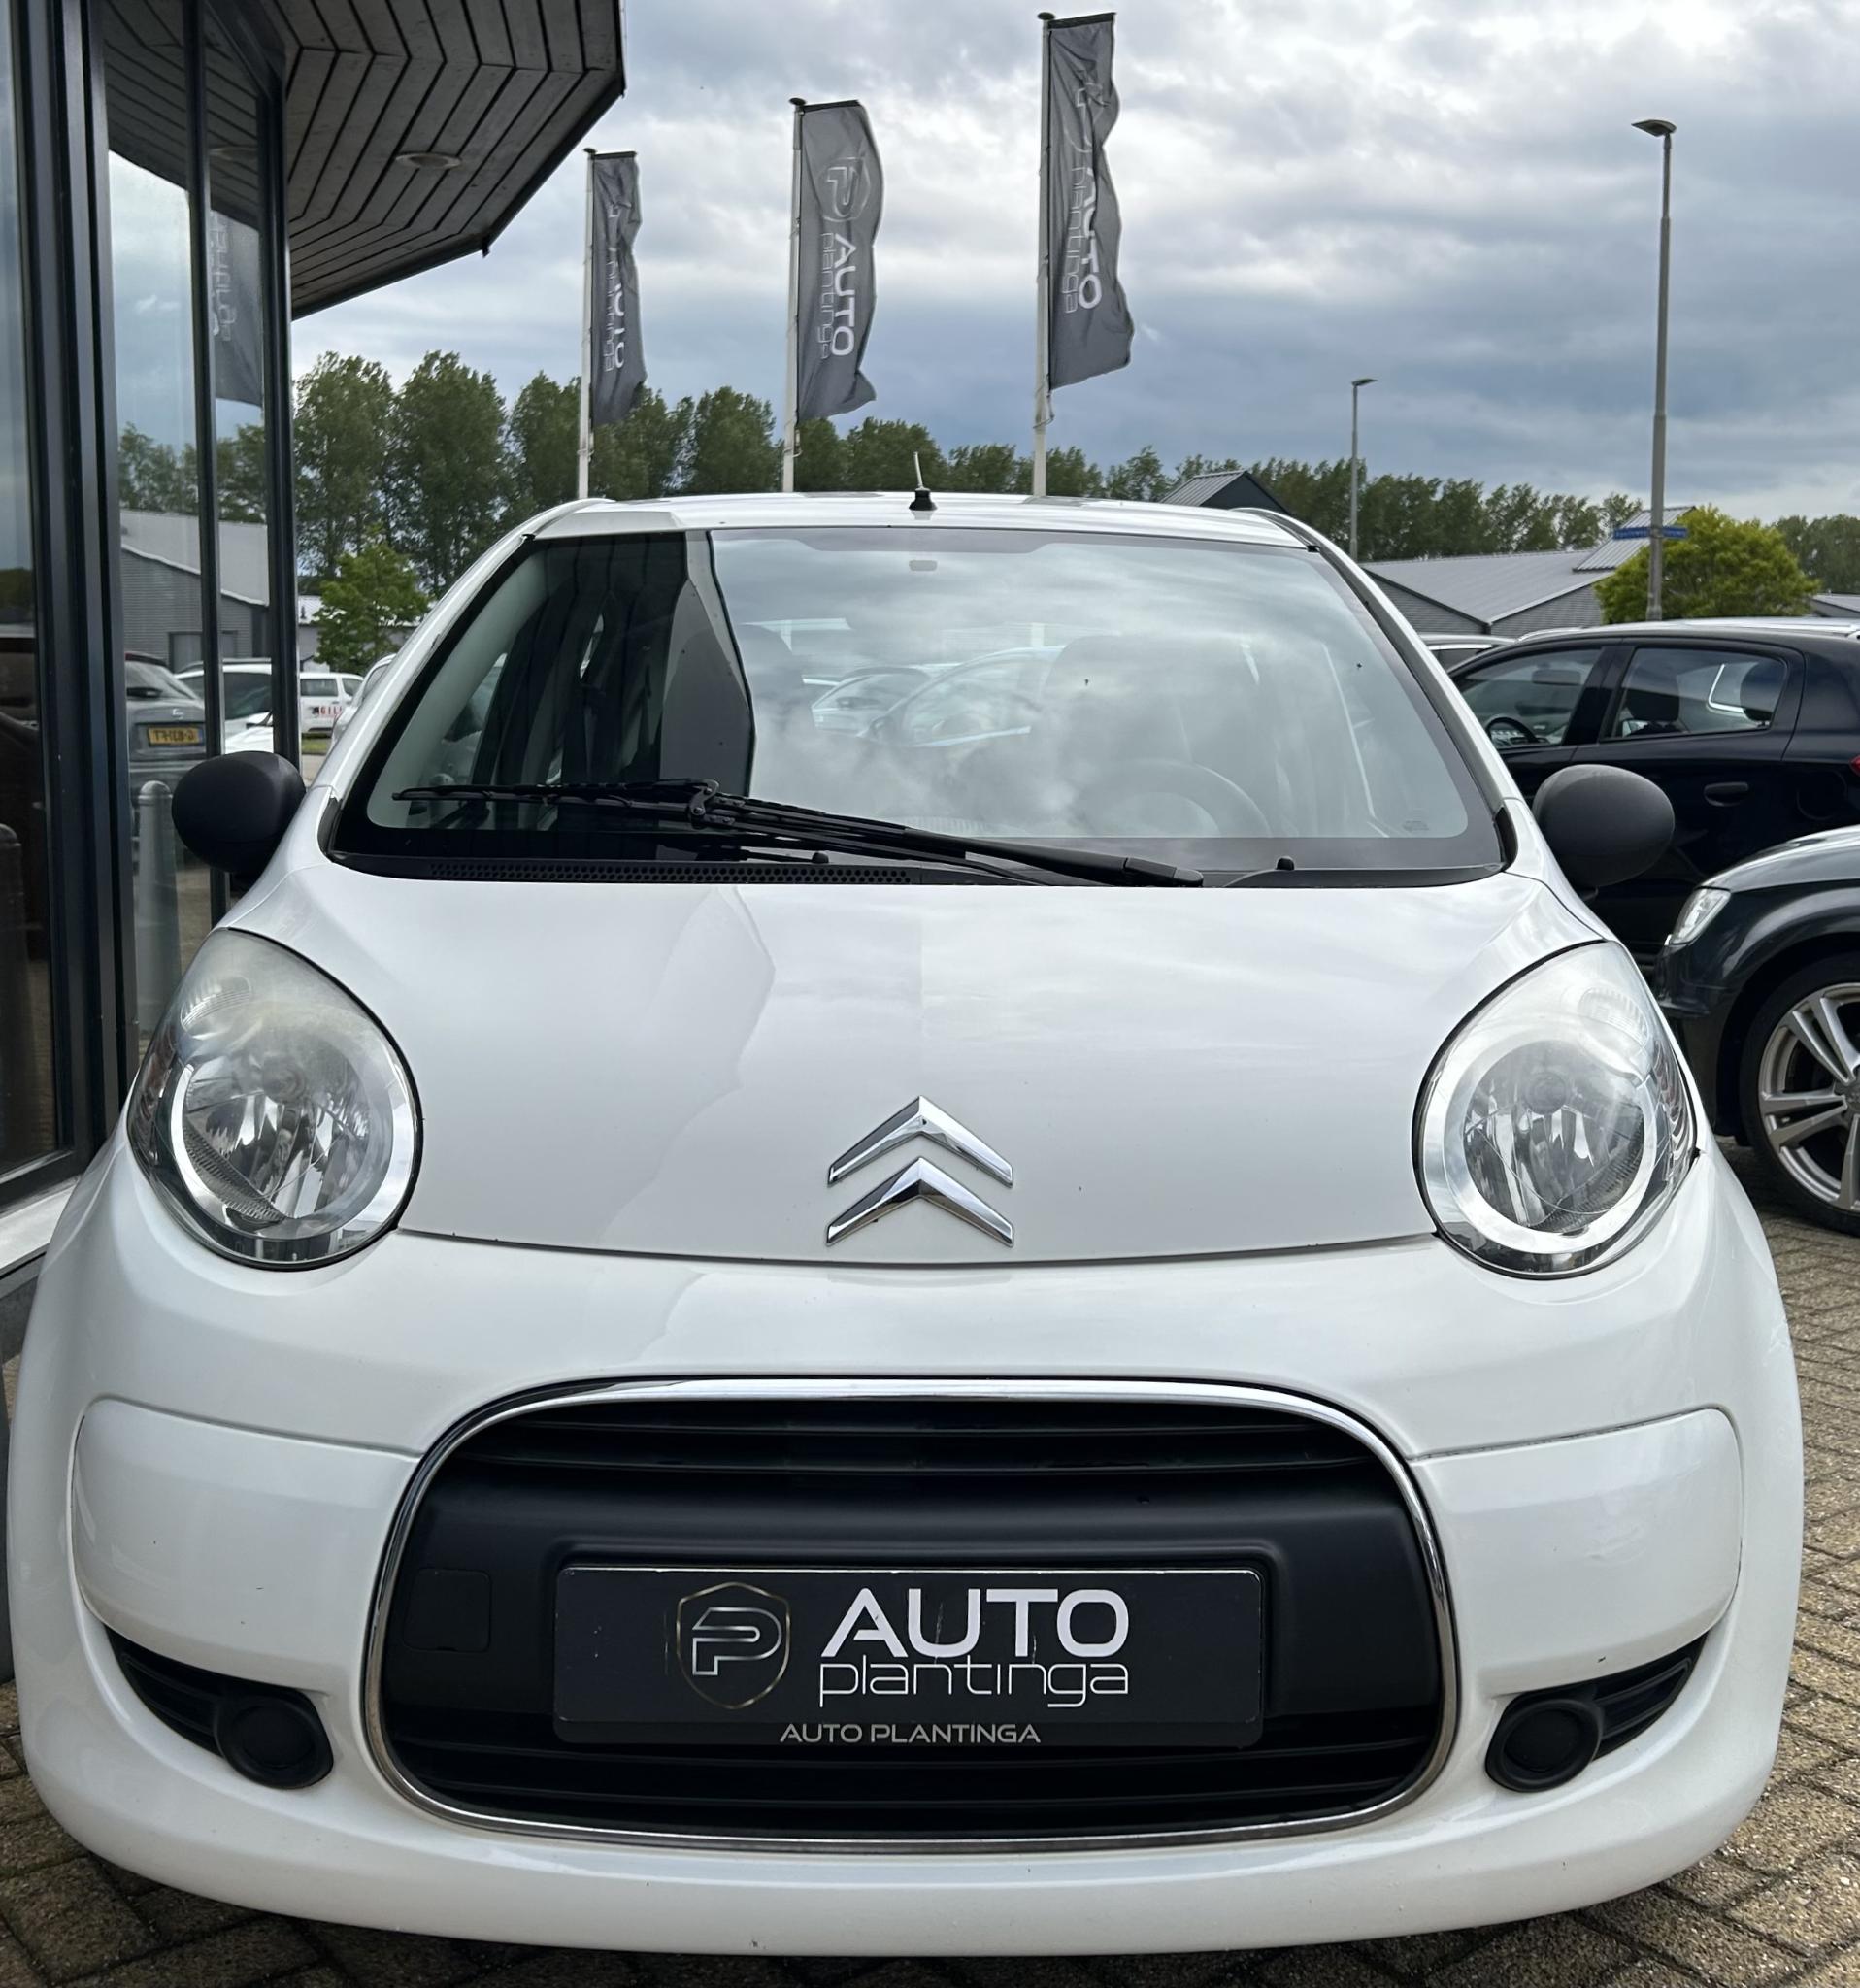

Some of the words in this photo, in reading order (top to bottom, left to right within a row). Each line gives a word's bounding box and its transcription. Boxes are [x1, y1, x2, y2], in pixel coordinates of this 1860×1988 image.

[831, 233, 856, 356] AUTO
[820, 1588, 1130, 1658] AUTO
[819, 1655, 1129, 1708] plantinga
[780, 1723, 863, 1743] AUTO
[871, 1723, 1042, 1744] PLANTINGA
